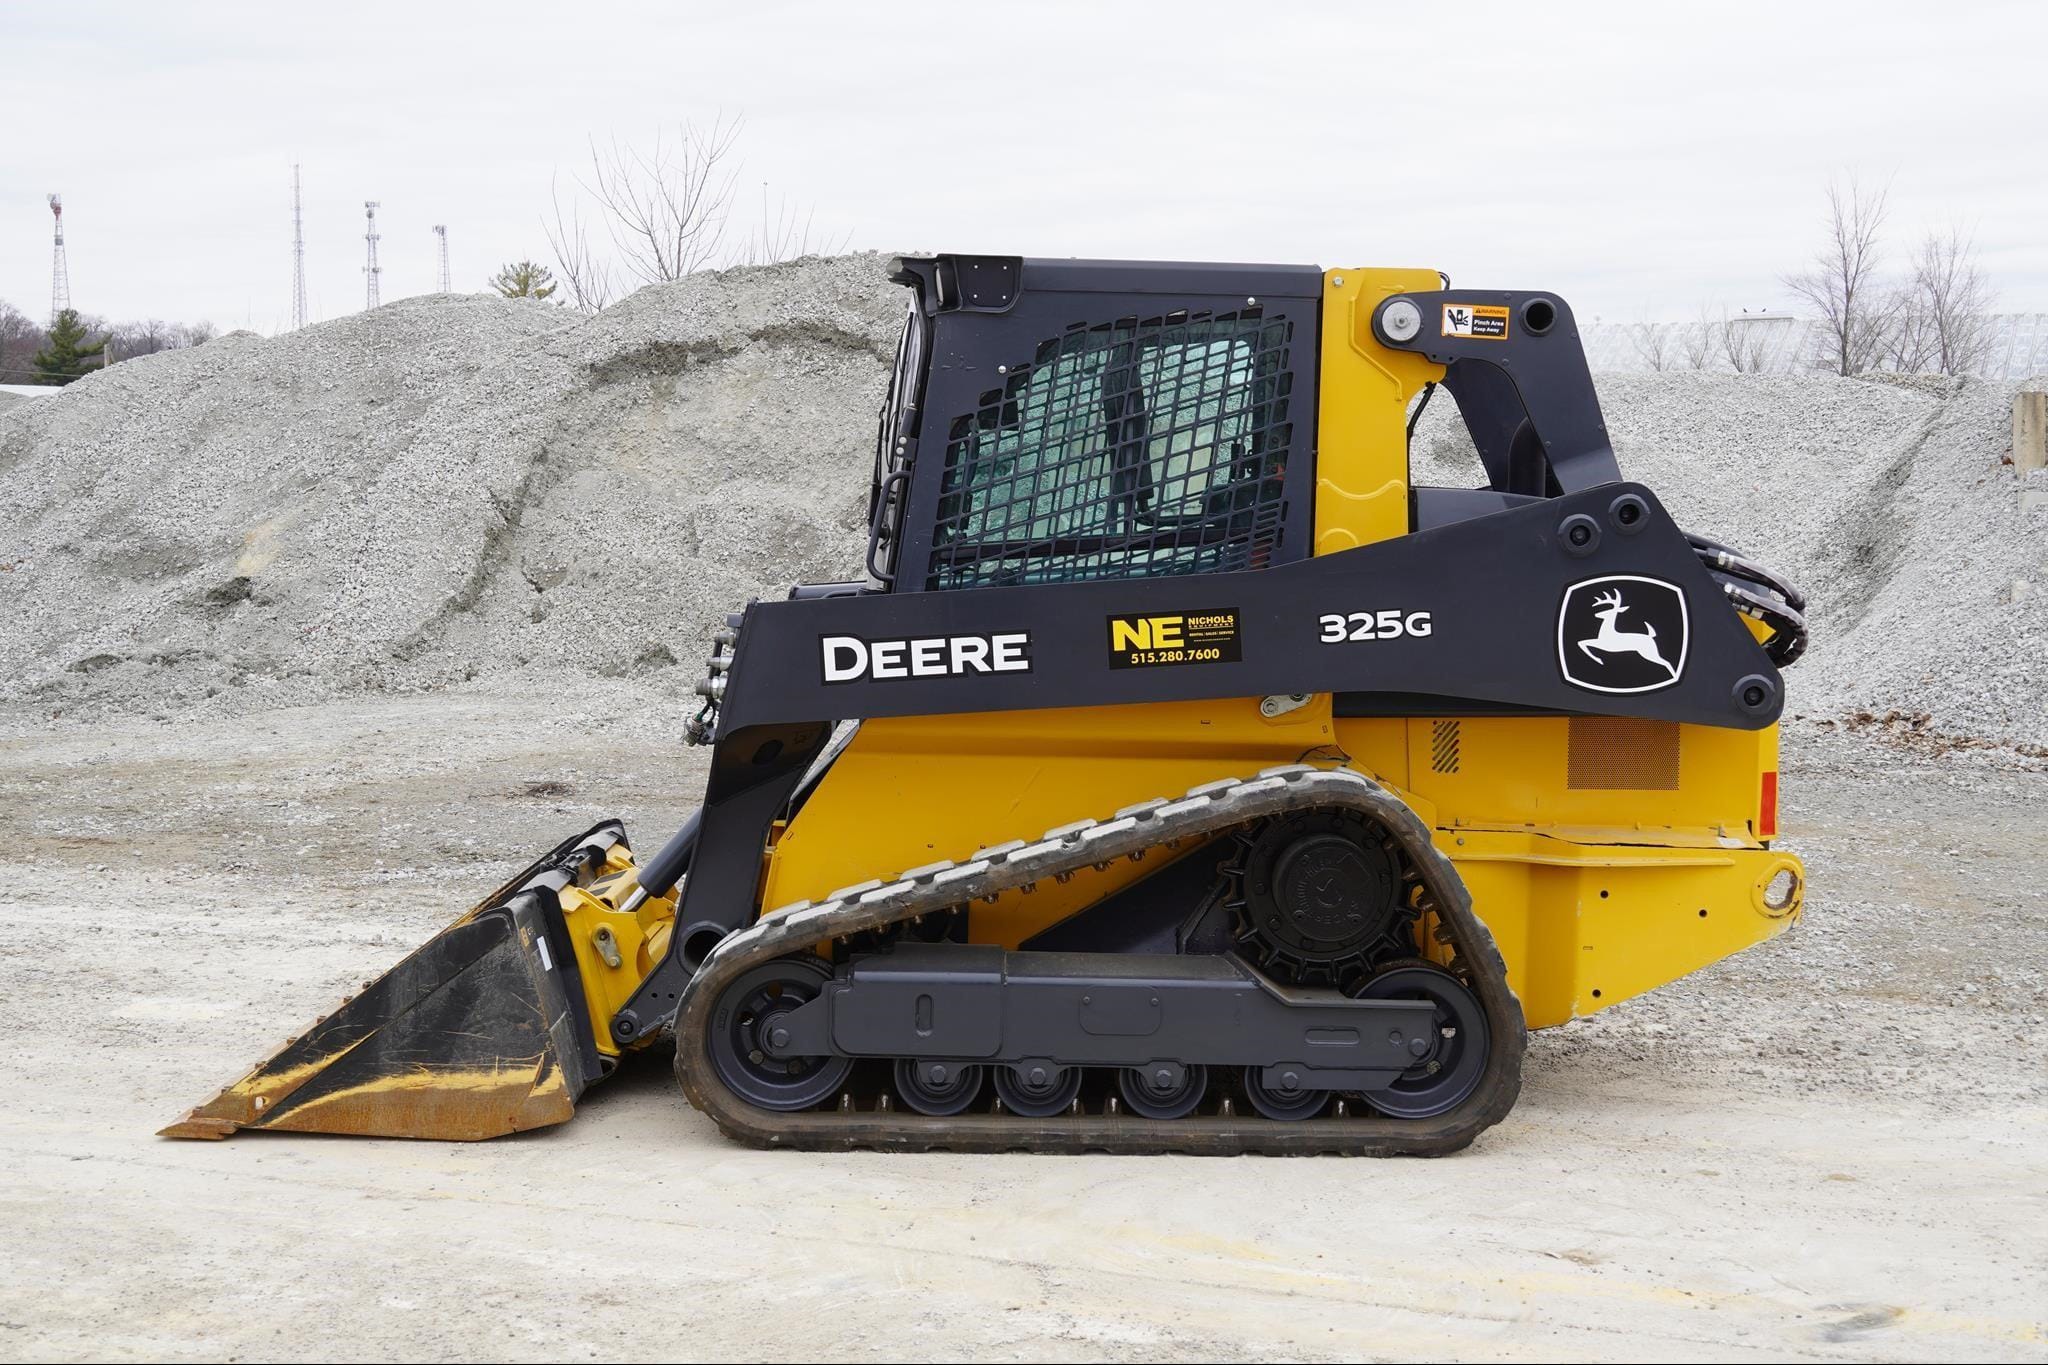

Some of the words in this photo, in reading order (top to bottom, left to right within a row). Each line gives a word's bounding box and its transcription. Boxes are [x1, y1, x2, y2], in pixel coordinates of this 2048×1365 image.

[1112, 616, 1184, 651] NE
[1188, 615, 1234, 625] NICHOLS
[1320, 610, 1432, 643] 325G
[823, 633, 1030, 682] DEERE
[1131, 648, 1220, 664] 515.280.7600
